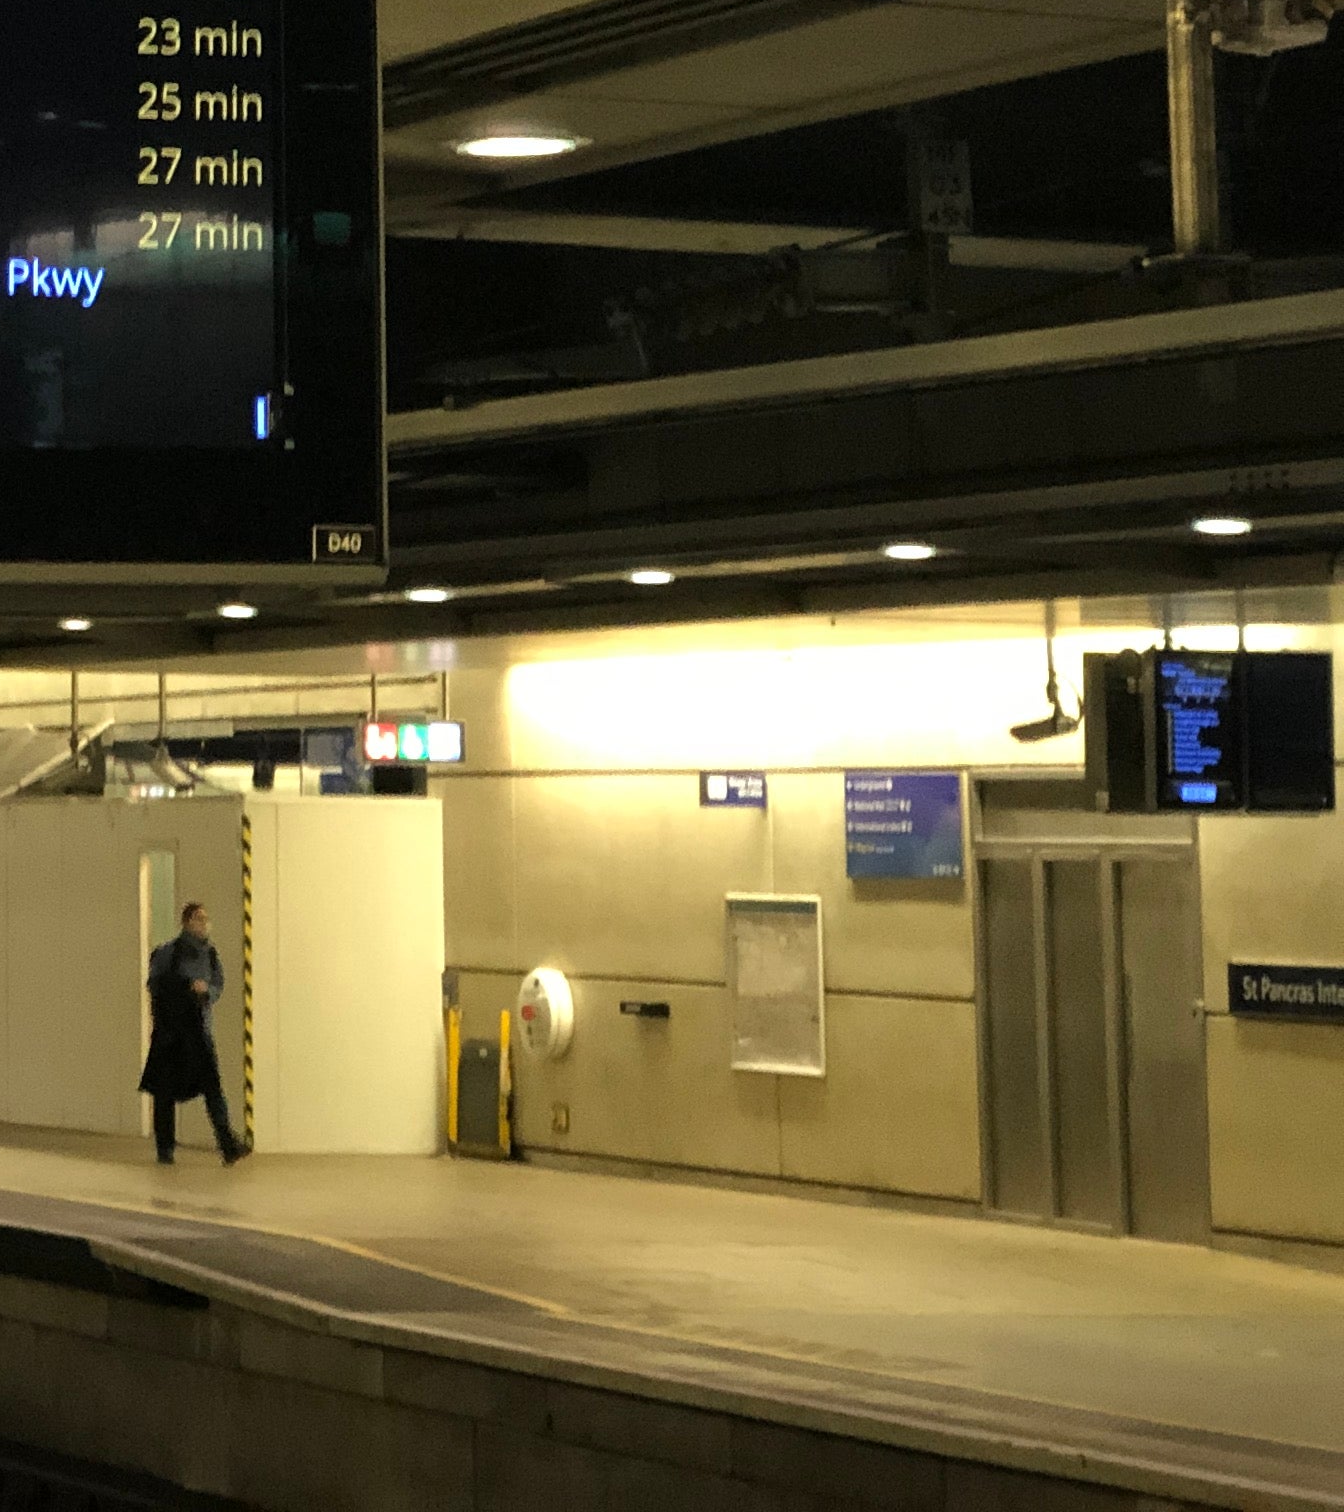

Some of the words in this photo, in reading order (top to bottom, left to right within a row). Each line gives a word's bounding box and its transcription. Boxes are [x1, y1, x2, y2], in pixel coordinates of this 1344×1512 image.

[137, 16, 181, 56] 23
[194, 20, 262, 57] min
[138, 81, 182, 121] 25
[195, 84, 263, 122] min
[137, 147, 182, 185] 27
[195, 149, 263, 186] min
[137, 211, 182, 250] 27
[194, 214, 263, 251] min
[6, 255, 106, 308] Pkwy
[1242, 975, 1258, 1002] St
[1261, 975, 1315, 1004] Pancras
